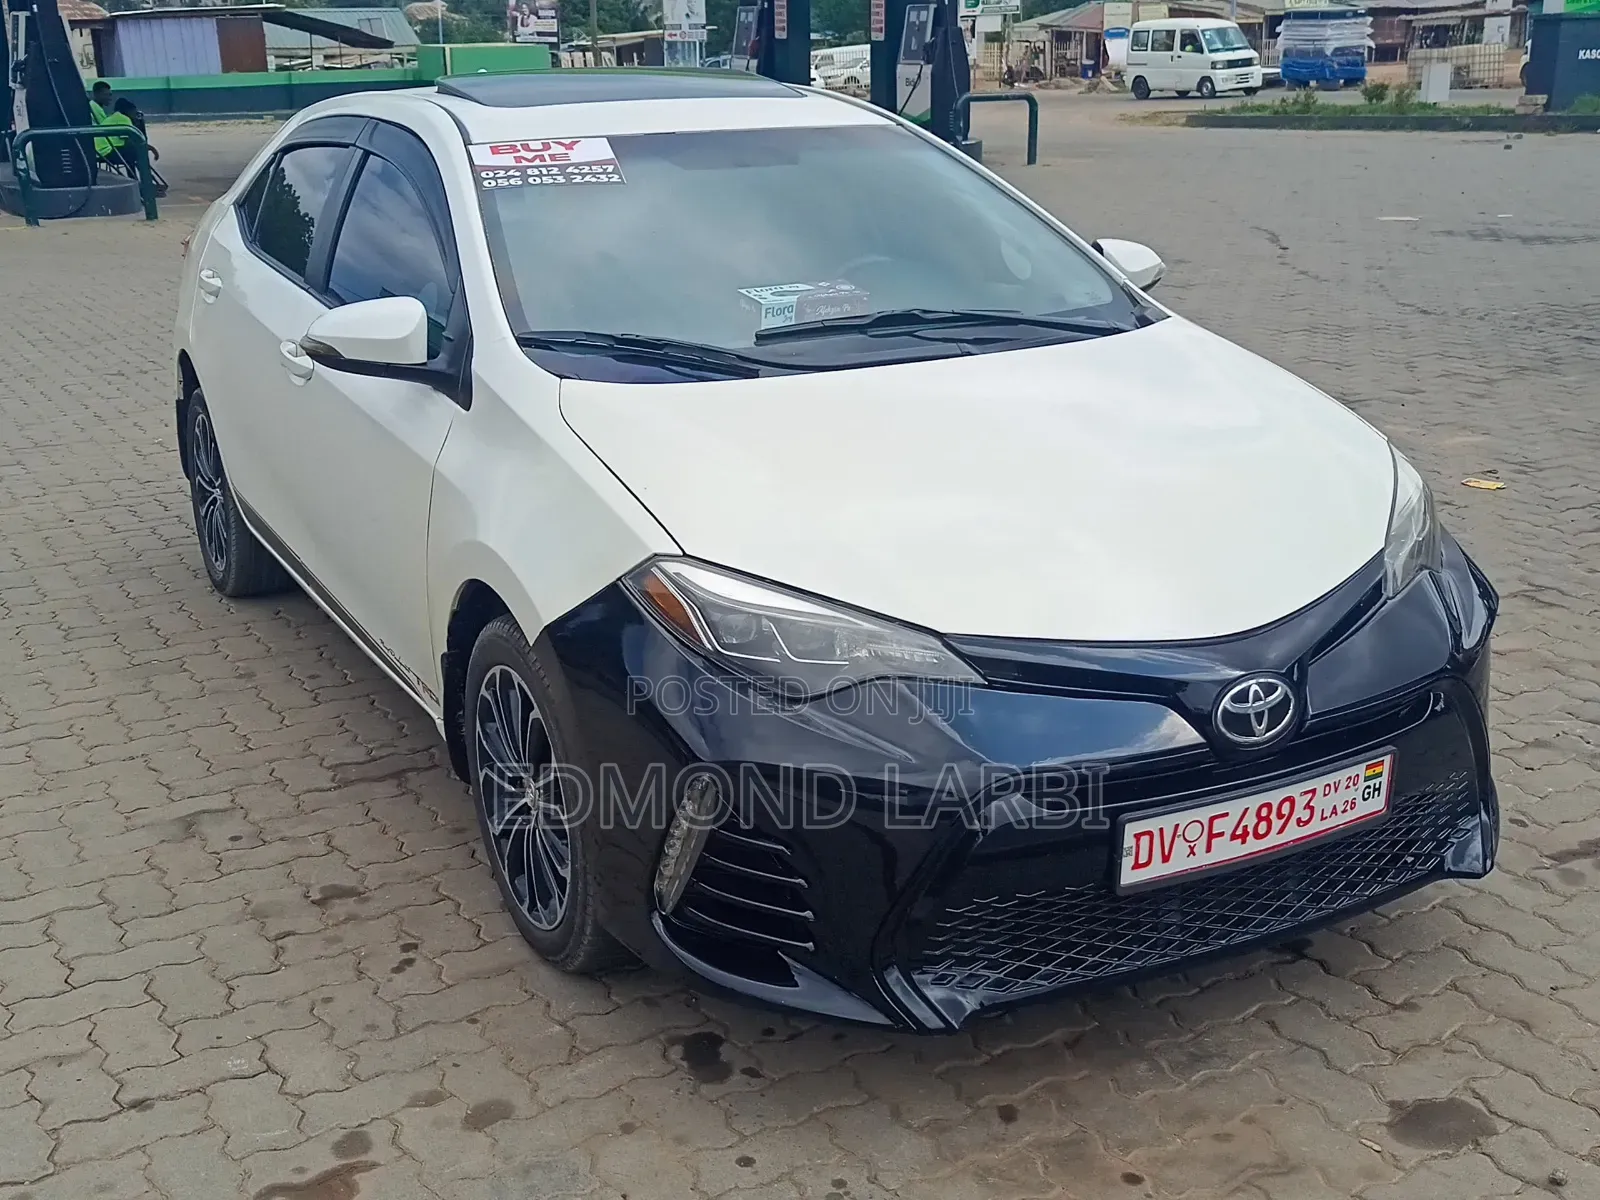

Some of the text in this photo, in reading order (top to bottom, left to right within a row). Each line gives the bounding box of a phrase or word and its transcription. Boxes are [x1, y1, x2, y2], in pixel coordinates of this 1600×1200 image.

[489, 140, 581, 155] BUY
[513, 153, 571, 164] ME
[480, 164, 615, 178] 024 812 4257
[482, 174, 621, 187] 056 053 2432
[764, 304, 794, 319] Flora
[1322, 773, 1360, 798] DV 20
[1361, 781, 1382, 802] GH
[1320, 799, 1357, 821] LA 26
[1131, 788, 1317, 871] DV F4893
